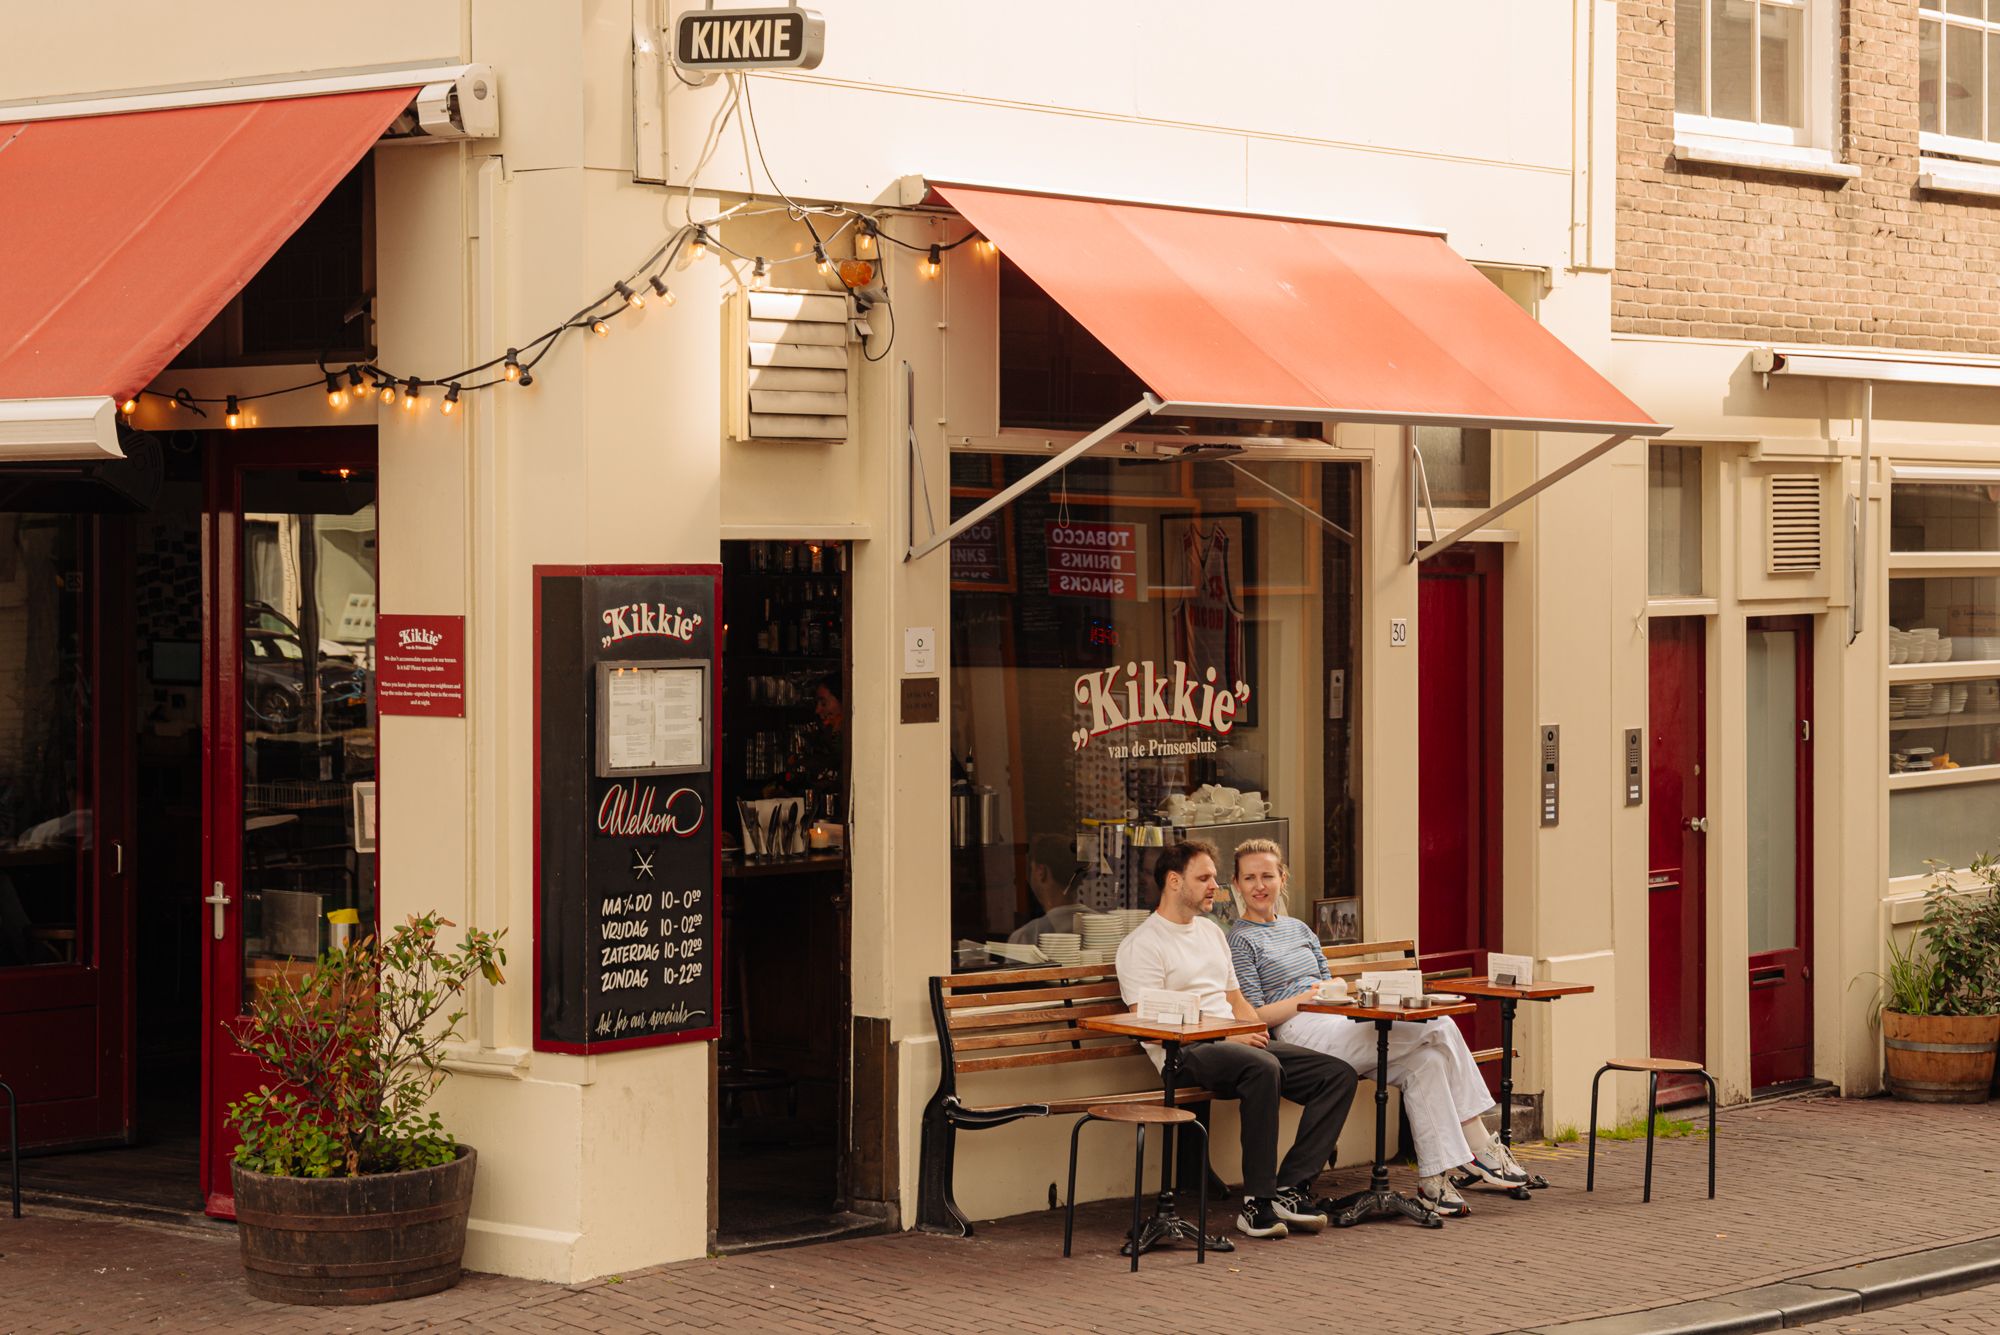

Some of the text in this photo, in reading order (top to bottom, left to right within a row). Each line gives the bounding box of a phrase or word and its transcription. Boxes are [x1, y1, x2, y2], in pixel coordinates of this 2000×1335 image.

[691, 19, 792, 60] KIKKIE
[1393, 623, 1406, 642] 30
[1108, 736, 1217, 759] van de Prinsensluis
[598, 778, 703, 836] Welkom
[601, 897, 622, 917] MA
[635, 893, 652, 912] DO
[601, 919, 649, 940] VRIJDAG
[601, 943, 660, 967] ZATERDAG
[601, 968, 649, 992] ZONDAG
[595, 1000, 706, 1039] Ask for our specials
